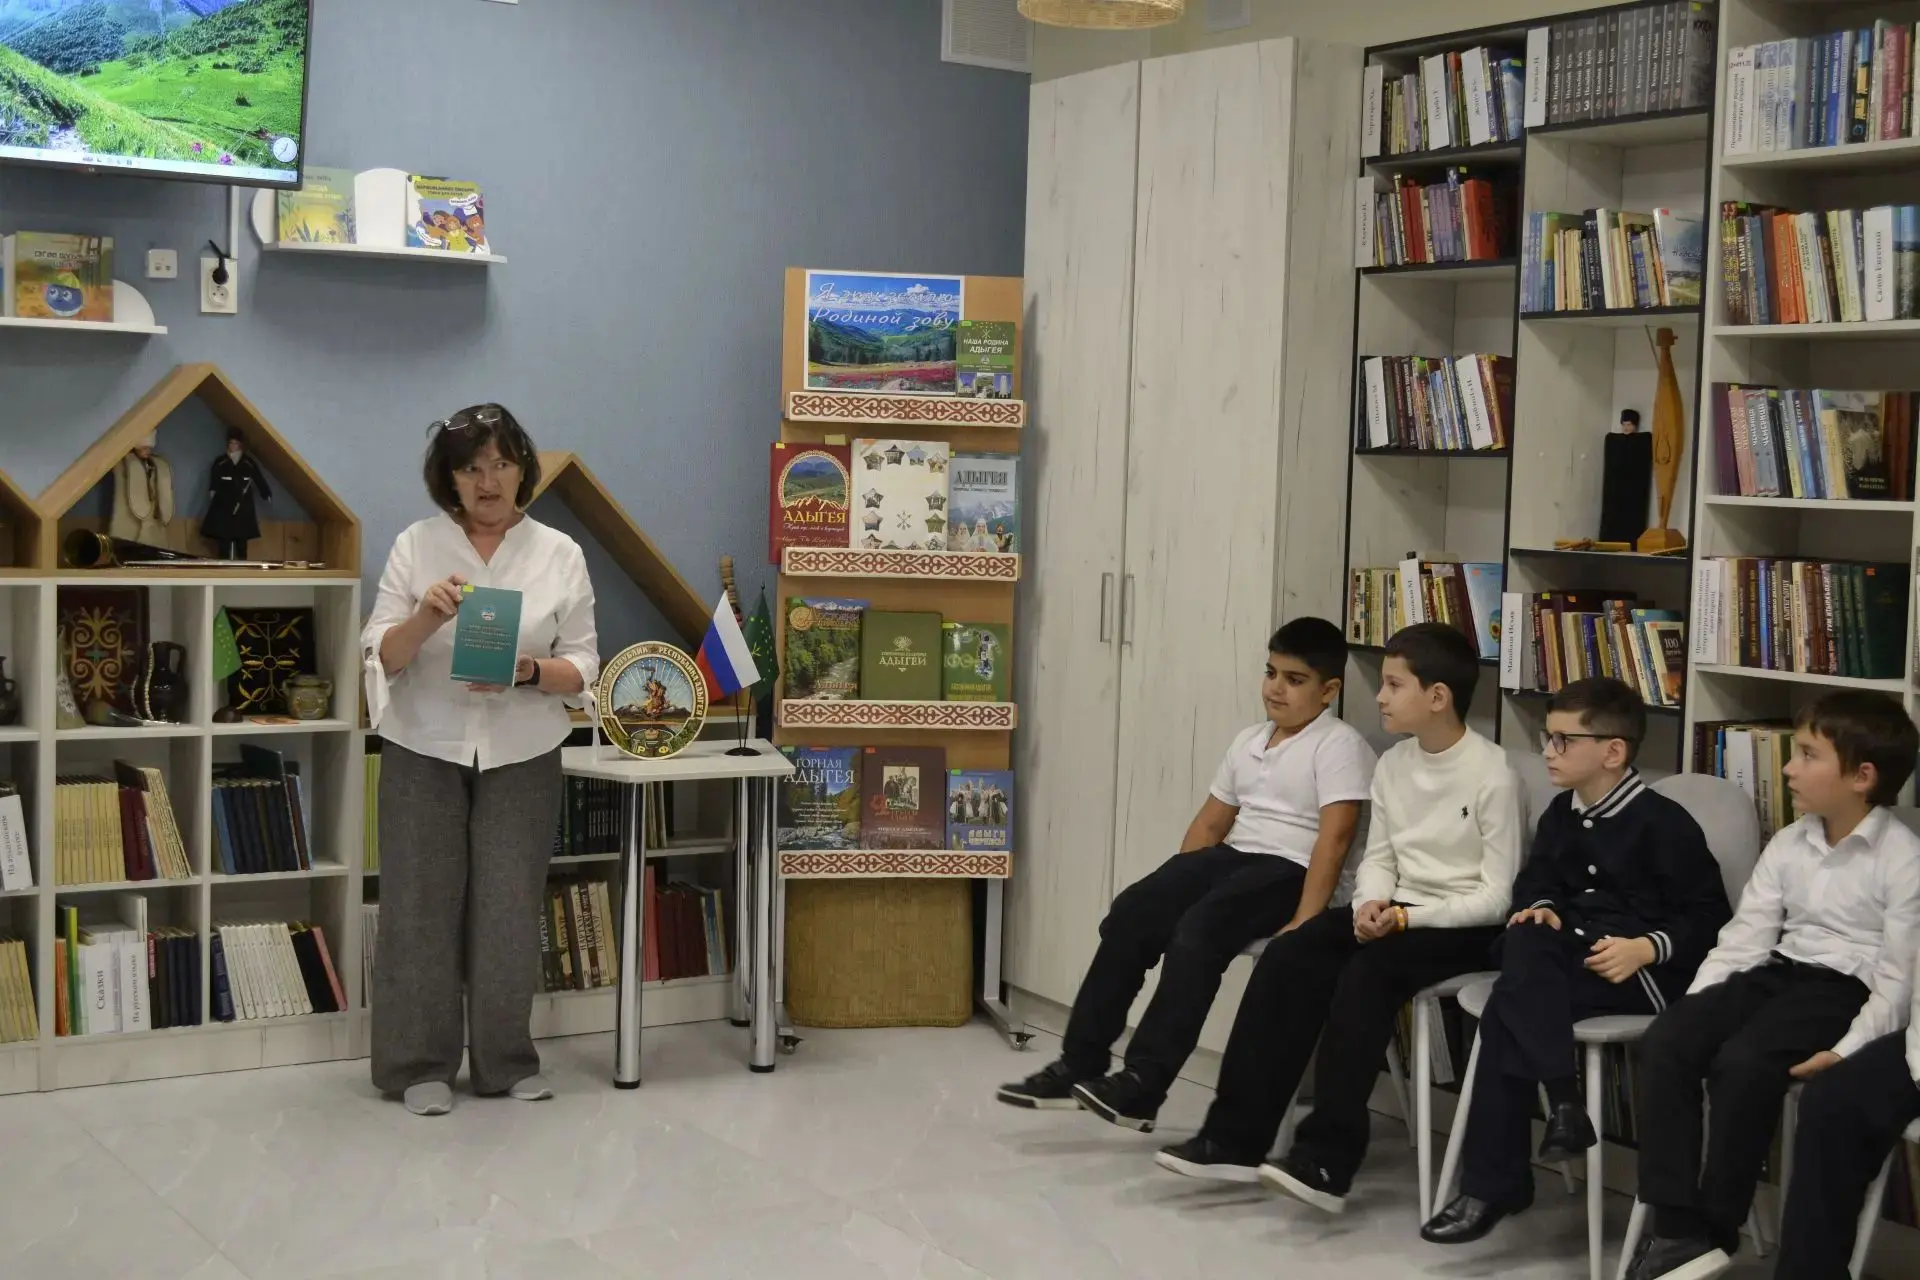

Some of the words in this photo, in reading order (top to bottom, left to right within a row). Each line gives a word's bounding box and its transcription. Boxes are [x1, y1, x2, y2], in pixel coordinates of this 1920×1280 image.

[816, 282, 835, 300] Я
[813, 308, 902, 325] Родиной
[904, 312, 955, 332] зову
[969, 346, 1003, 354] АДЫГЕЯ
[953, 470, 1009, 487] АДЫГЕЯ
[783, 510, 846, 524] АДЫГЕЯ
[1664, 638, 1679, 649] 100
[878, 656, 927, 667] АДЫГЕИ
[796, 758, 842, 769] ГОРНАЯ
[783, 769, 856, 785] АДЫГЕЯ
[96, 969, 105, 1011] Сказки
